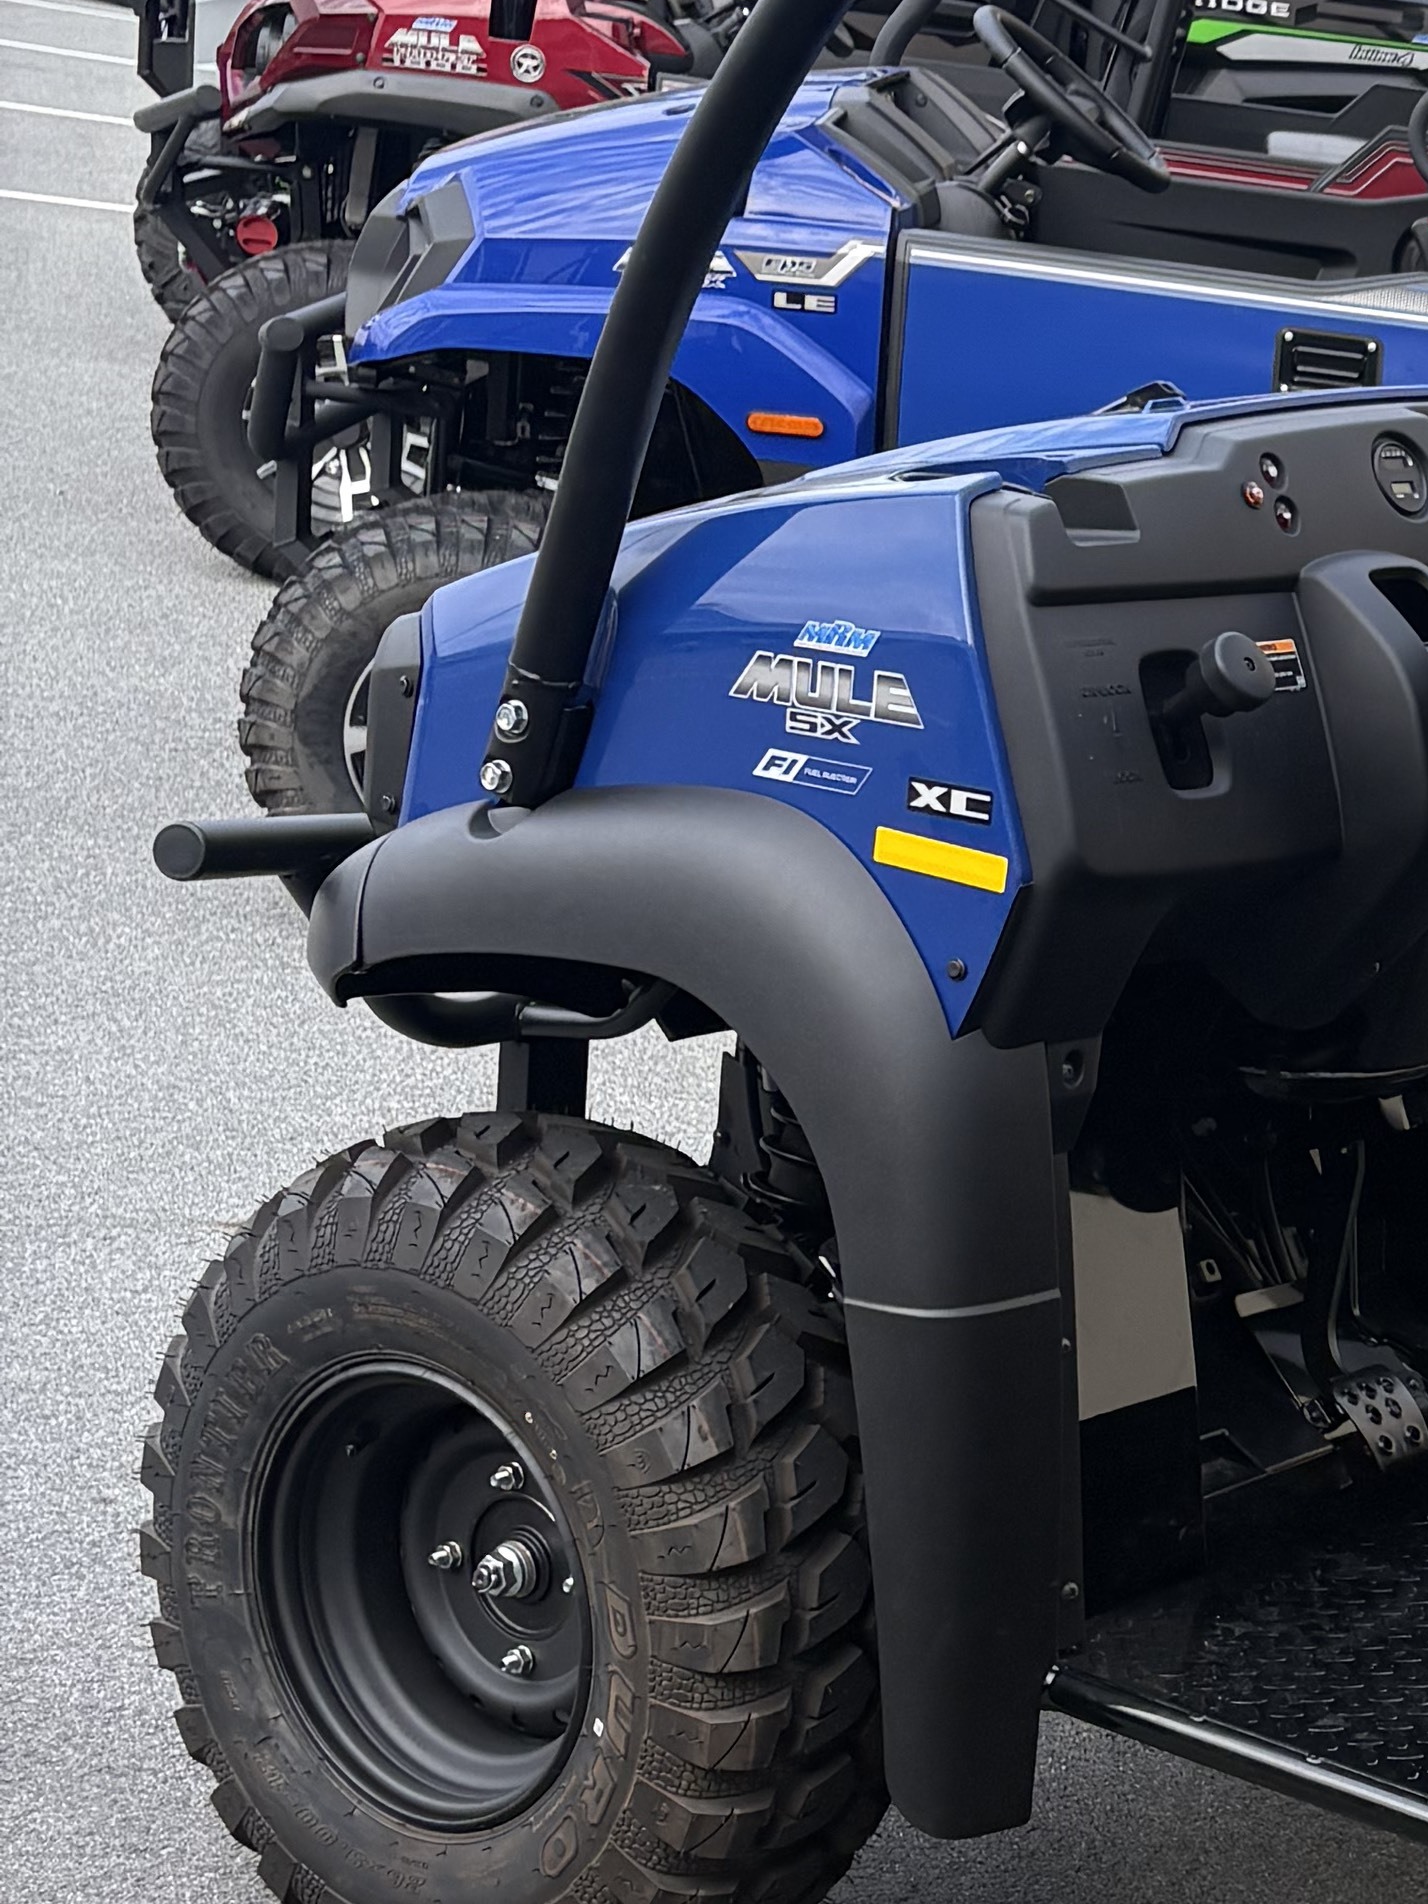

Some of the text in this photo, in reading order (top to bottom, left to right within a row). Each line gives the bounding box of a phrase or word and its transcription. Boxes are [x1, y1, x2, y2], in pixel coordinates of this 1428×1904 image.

[774, 292, 835, 312] LE
[797, 620, 880, 654] MRM
[729, 650, 924, 729] MULE
[786, 708, 860, 744] SX
[762, 755, 799, 775] FI
[909, 780, 992, 821] XC
[540, 1582, 636, 1877] DURO
